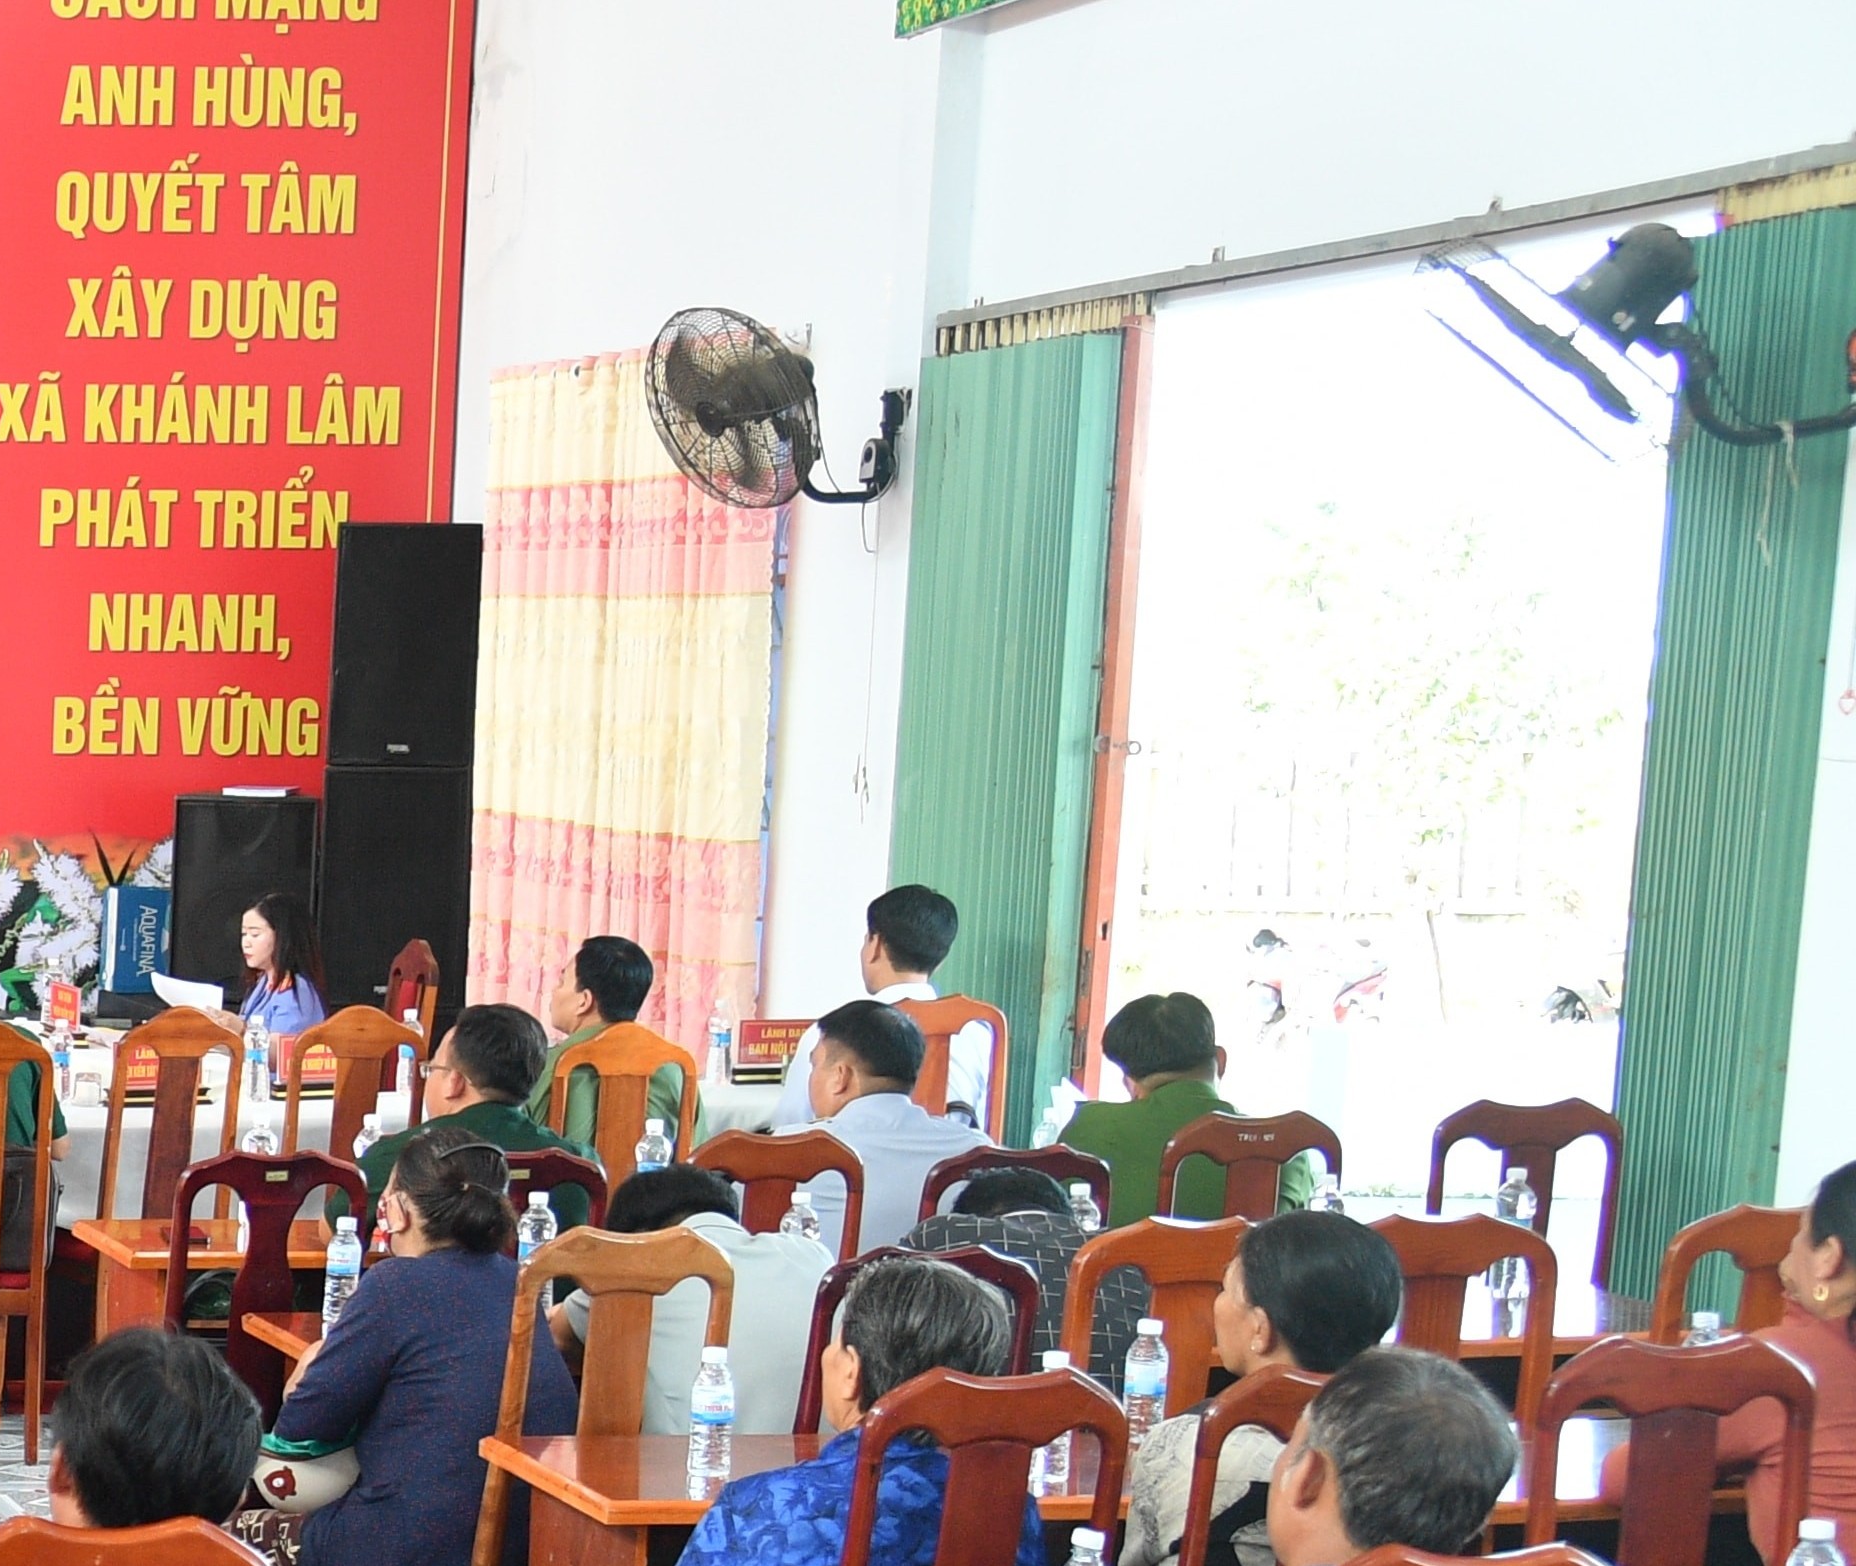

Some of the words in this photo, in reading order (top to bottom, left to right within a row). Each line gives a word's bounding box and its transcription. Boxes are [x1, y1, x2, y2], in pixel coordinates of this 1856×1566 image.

[59, 65, 176, 127] ANH
[192, 53, 358, 137] HÙNG,
[55, 153, 225, 240] QUYẾT
[241, 160, 358, 235] TÂM
[65, 265, 173, 340] XÂY
[189, 273, 338, 353] DỰNG
[83, 371, 269, 446] KHÁNH
[286, 372, 402, 446] LÂM
[38, 475, 179, 549] PHÁT
[194, 465, 350, 550] TRIỂN
[88, 592, 291, 661] NHANH,
[52, 677, 160, 755] BỀN
[177, 685, 320, 757] VỮNG
[136, 905, 159, 977] AQUAFINA
